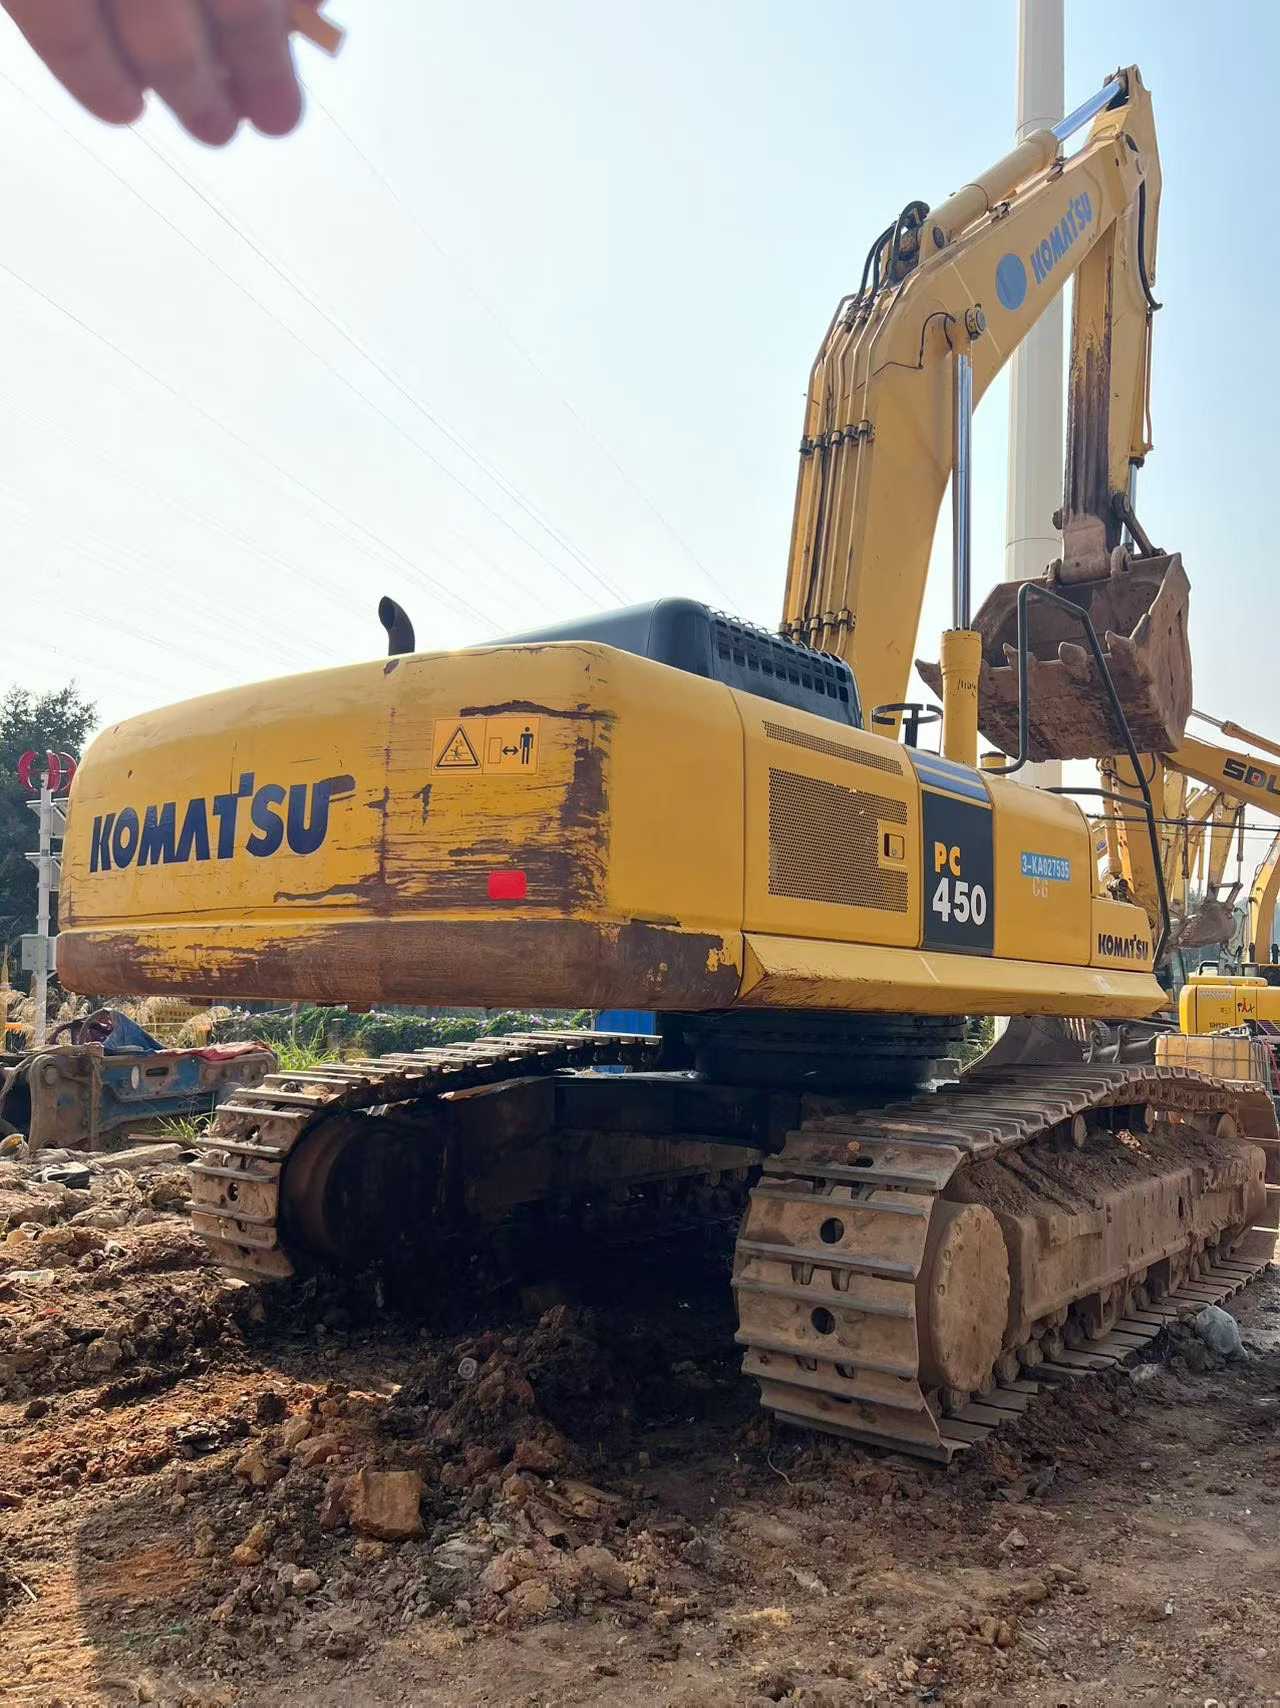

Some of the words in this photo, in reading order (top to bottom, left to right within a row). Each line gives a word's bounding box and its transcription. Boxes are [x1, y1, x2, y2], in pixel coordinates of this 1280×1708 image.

[1031, 191, 1092, 285] KOMATSU
[89, 772, 334, 873] KOMATSU
[934, 841, 961, 876] PC
[932, 877, 987, 926] 450
[1098, 933, 1149, 961] KOMATSU
